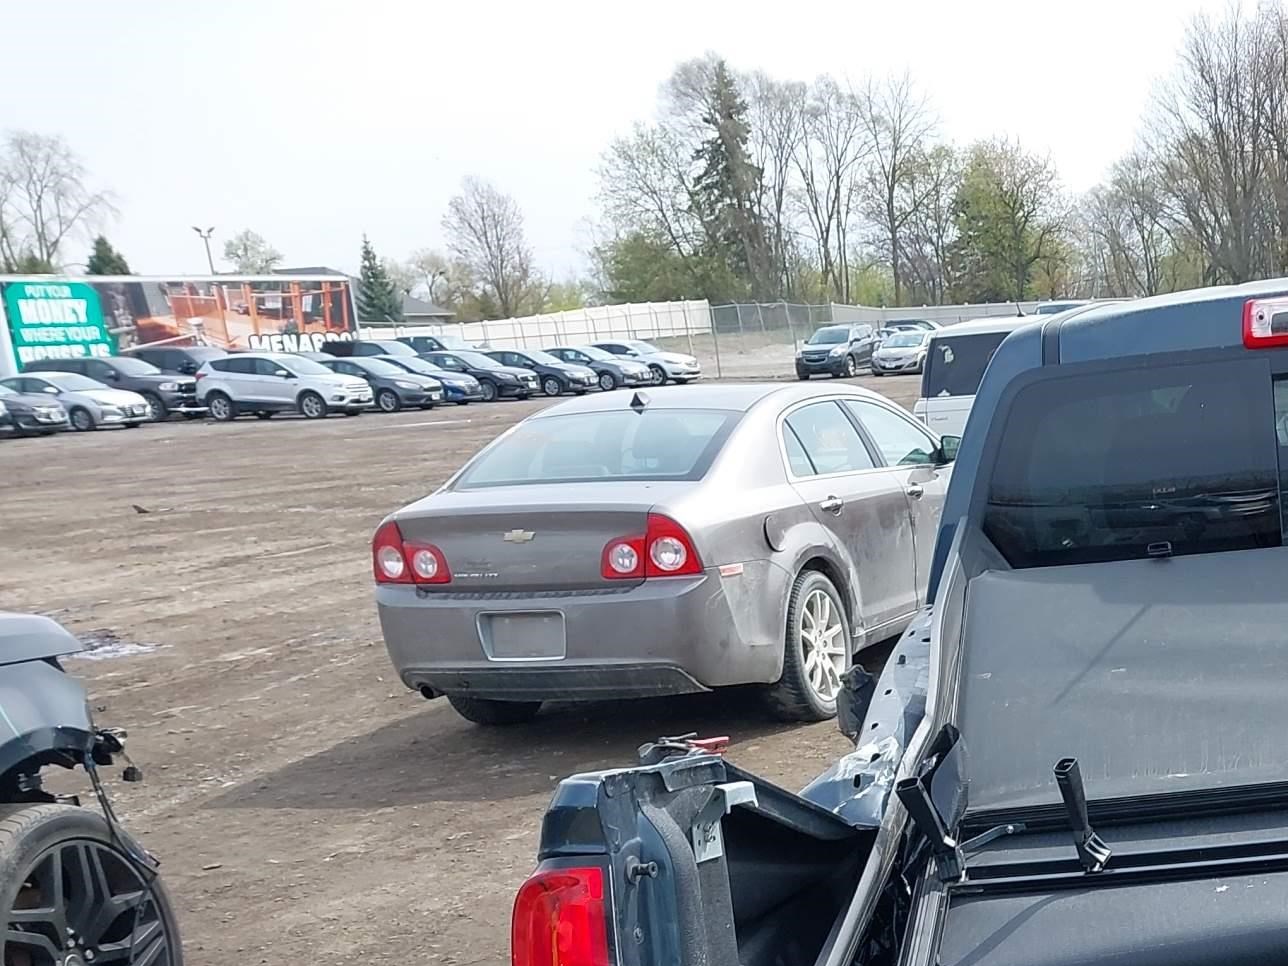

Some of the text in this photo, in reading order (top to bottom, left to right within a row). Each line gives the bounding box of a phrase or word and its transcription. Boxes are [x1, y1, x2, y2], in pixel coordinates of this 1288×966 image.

[17, 298, 87, 324] MONEY
[20, 325, 101, 342] WHERE YOUR
